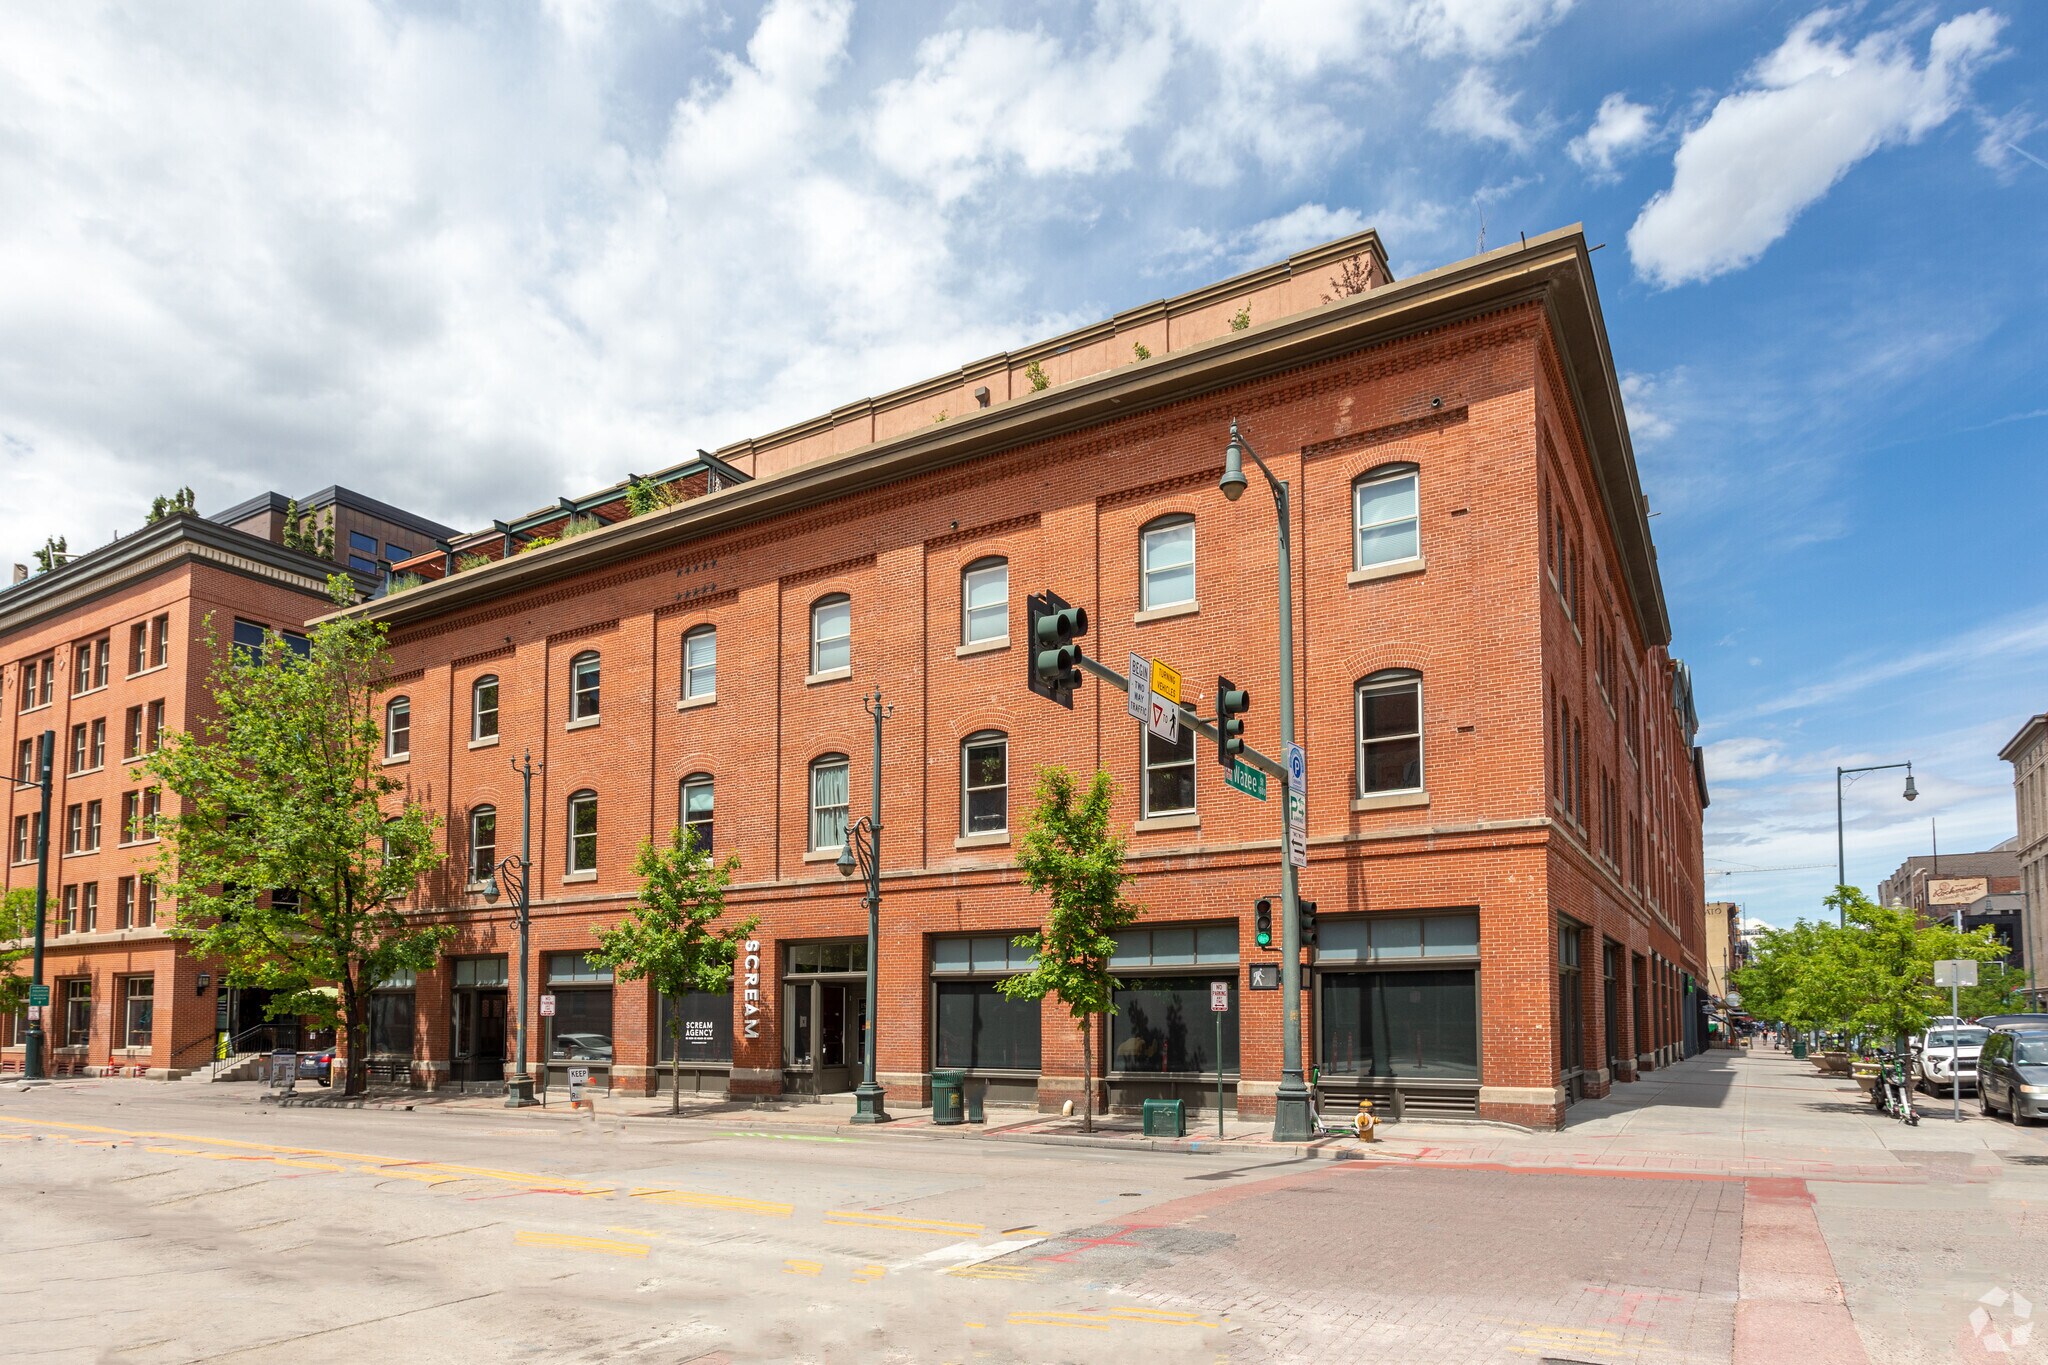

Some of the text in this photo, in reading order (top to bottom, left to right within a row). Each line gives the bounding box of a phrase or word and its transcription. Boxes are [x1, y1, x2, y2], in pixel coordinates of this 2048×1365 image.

[1132, 659, 1148, 679] BEGIN
[1159, 667, 1175, 685] TURNING
[1134, 680, 1145, 693] TWO
[1157, 680, 1176, 698] VEHICLES
[1133, 692, 1144, 703] WAY
[1130, 701, 1147, 716] TRAFFIC
[1162, 713, 1168, 724] TO
[1233, 765, 1257, 793] Wazee
[1932, 883, 1984, 898] Rockmount
[744, 939, 760, 1039] SCREAM
[686, 1021, 713, 1029] SCREAM
[571, 1070, 587, 1078] KEEP
